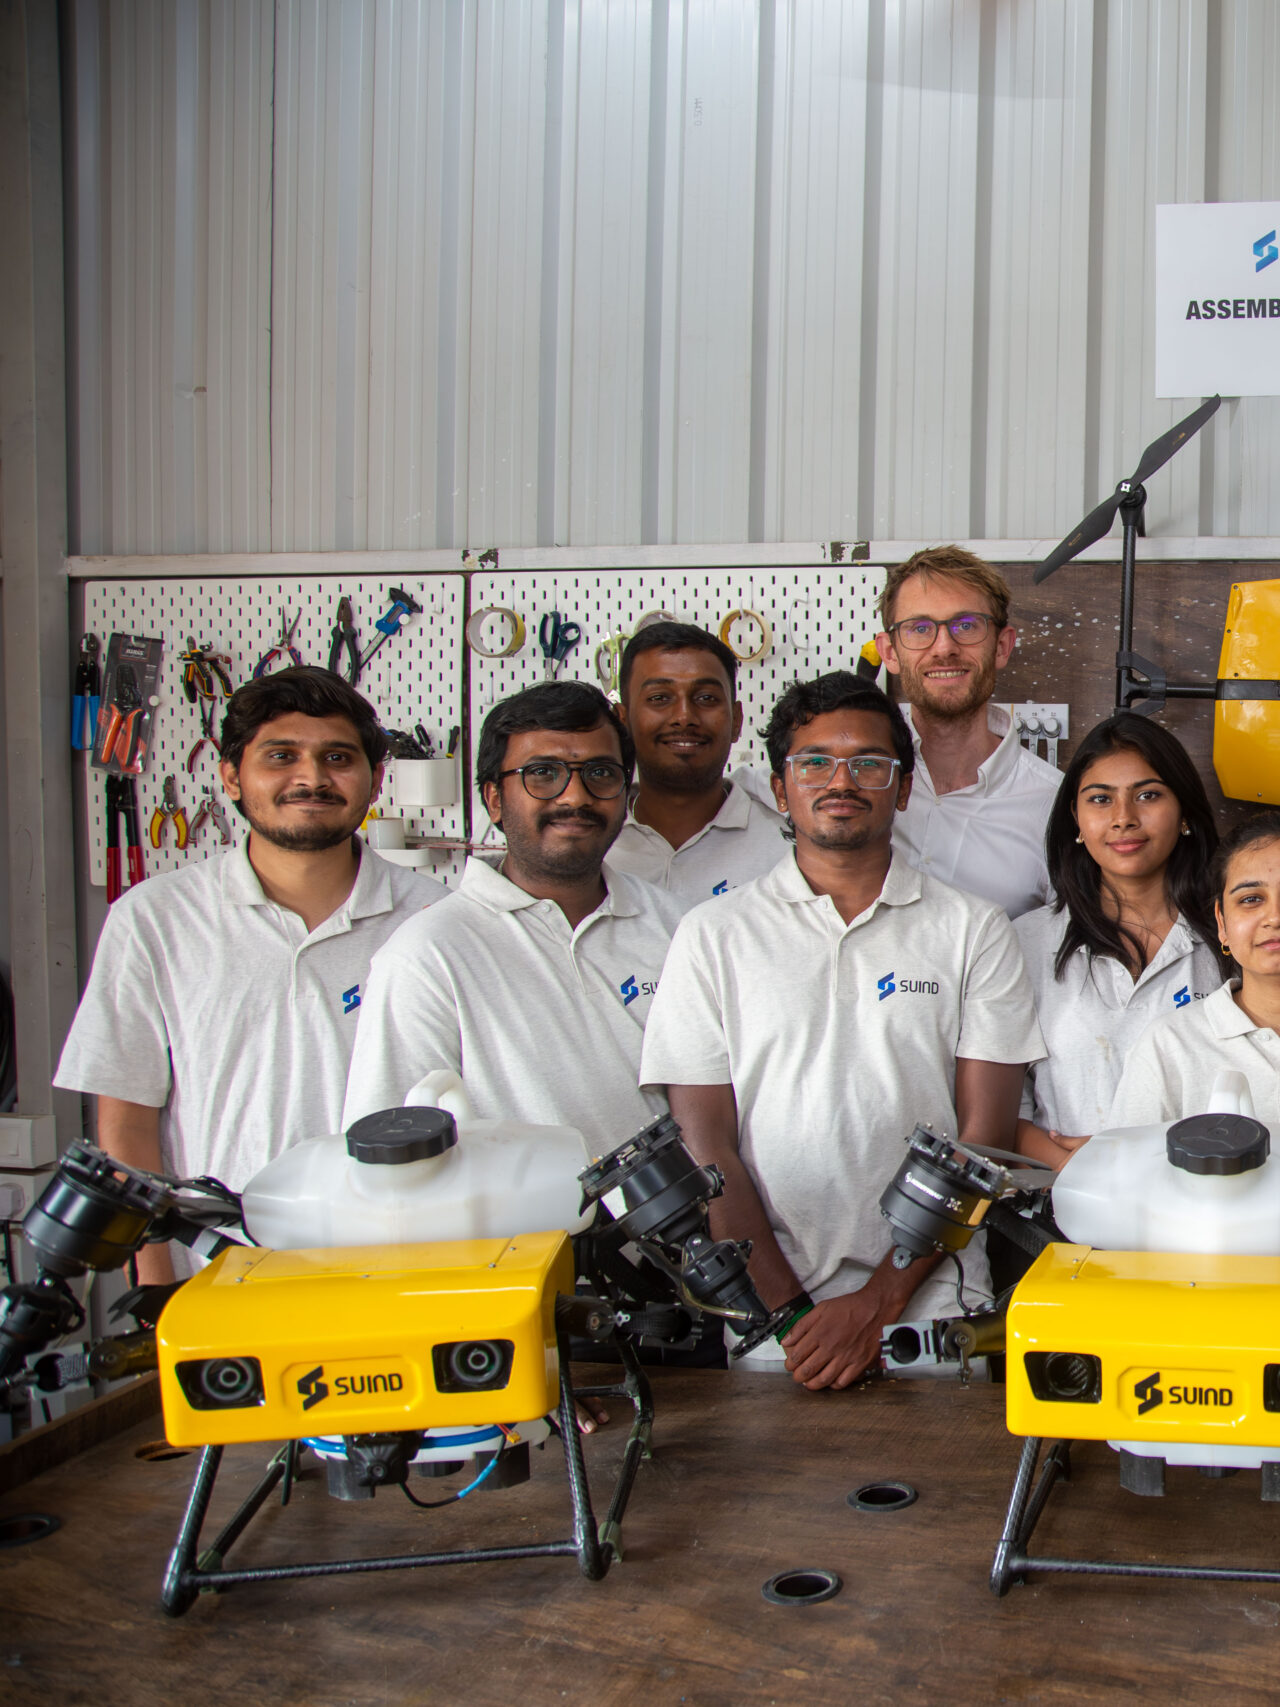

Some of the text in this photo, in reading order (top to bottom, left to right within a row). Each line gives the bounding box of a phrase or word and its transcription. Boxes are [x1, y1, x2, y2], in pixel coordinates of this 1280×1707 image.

[900, 979, 939, 995] SUIND
[334, 1372, 404, 1396] SUIND
[1168, 1386, 1233, 1407] SUIND
